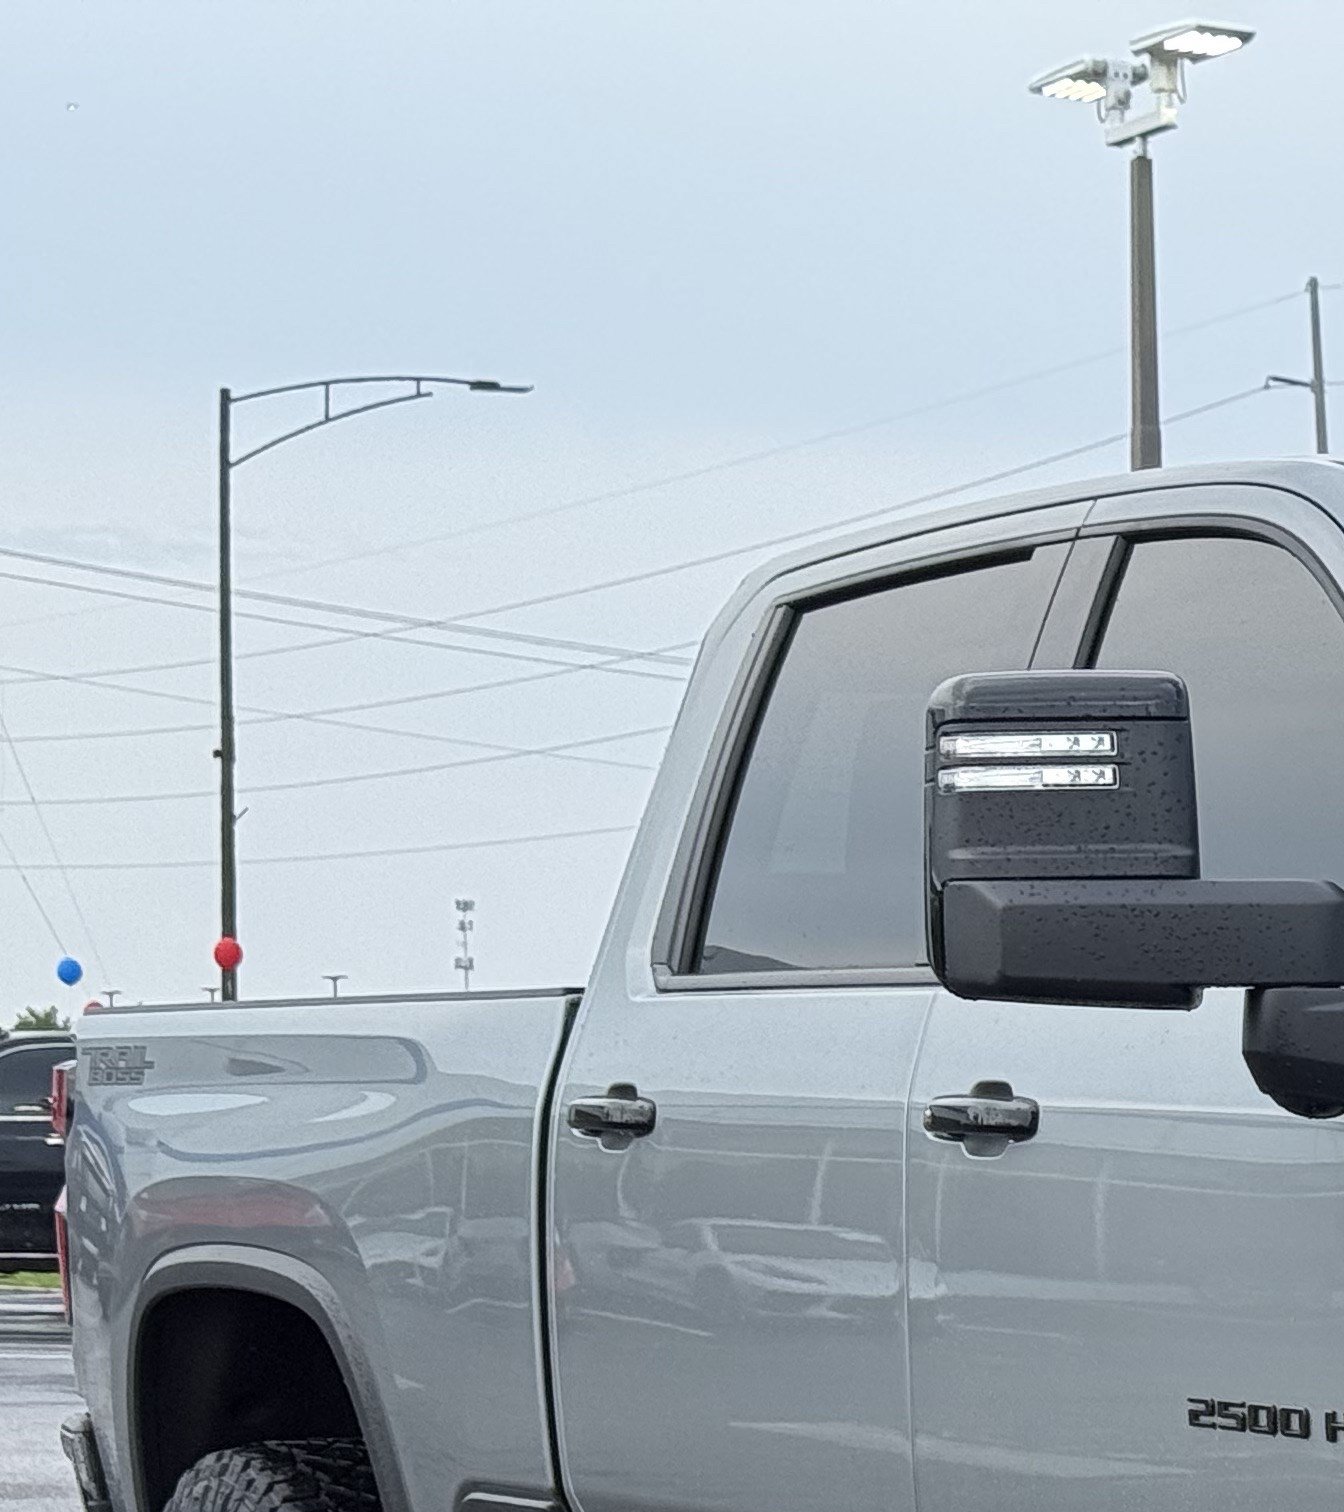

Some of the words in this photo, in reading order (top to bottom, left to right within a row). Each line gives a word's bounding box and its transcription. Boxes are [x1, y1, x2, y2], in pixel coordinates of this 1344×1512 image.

[81, 1046, 155, 1070] TRAIL
[88, 1069, 146, 1087] BOSS
[1187, 1397, 1311, 1440] 2500
